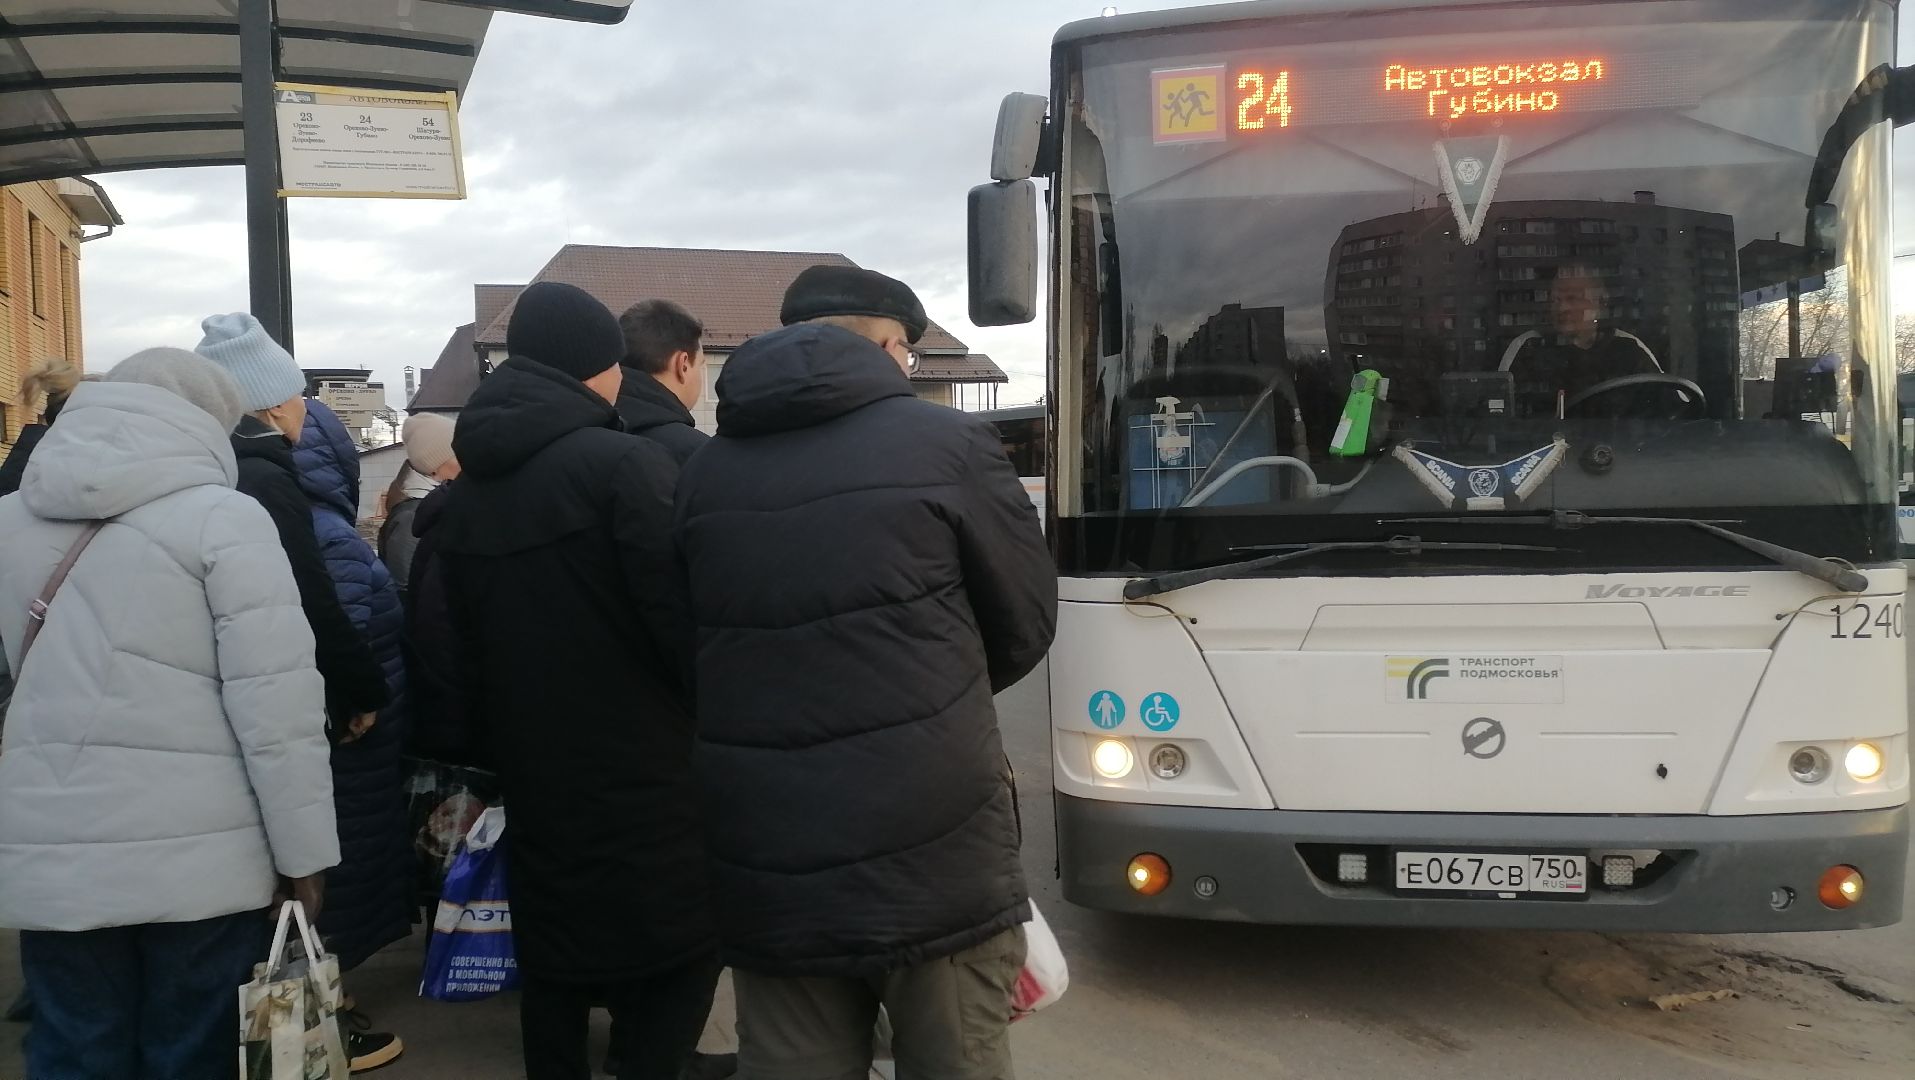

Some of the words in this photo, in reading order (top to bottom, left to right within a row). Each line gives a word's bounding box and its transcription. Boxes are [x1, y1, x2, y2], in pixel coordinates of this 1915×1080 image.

[1385, 59, 1605, 91] Автовокзал
[1237, 71, 1292, 130] 24
[1427, 89, 1559, 119] Губино
[299, 112, 313, 122] 23
[359, 115, 372, 124] 24
[422, 117, 435, 127] 54
[1426, 459, 1456, 490] SCANIA
[1510, 454, 1541, 486] SCANIA
[1830, 602, 1905, 639] 1240
[1459, 658, 1536, 667] ТРАНСПОРТ
[1459, 669, 1559, 680] ПОДМОСКОВЬЯ
[1532, 858, 1577, 879] 750
[1542, 879, 1566, 889] RUS
[451, 956, 503, 968] СОВЕРШЕННО
[448, 969, 454, 979] В
[456, 970, 506, 981] МОБИЛЬНОМ
[446, 983, 501, 992] ПРИЛОЖЕНИИ
